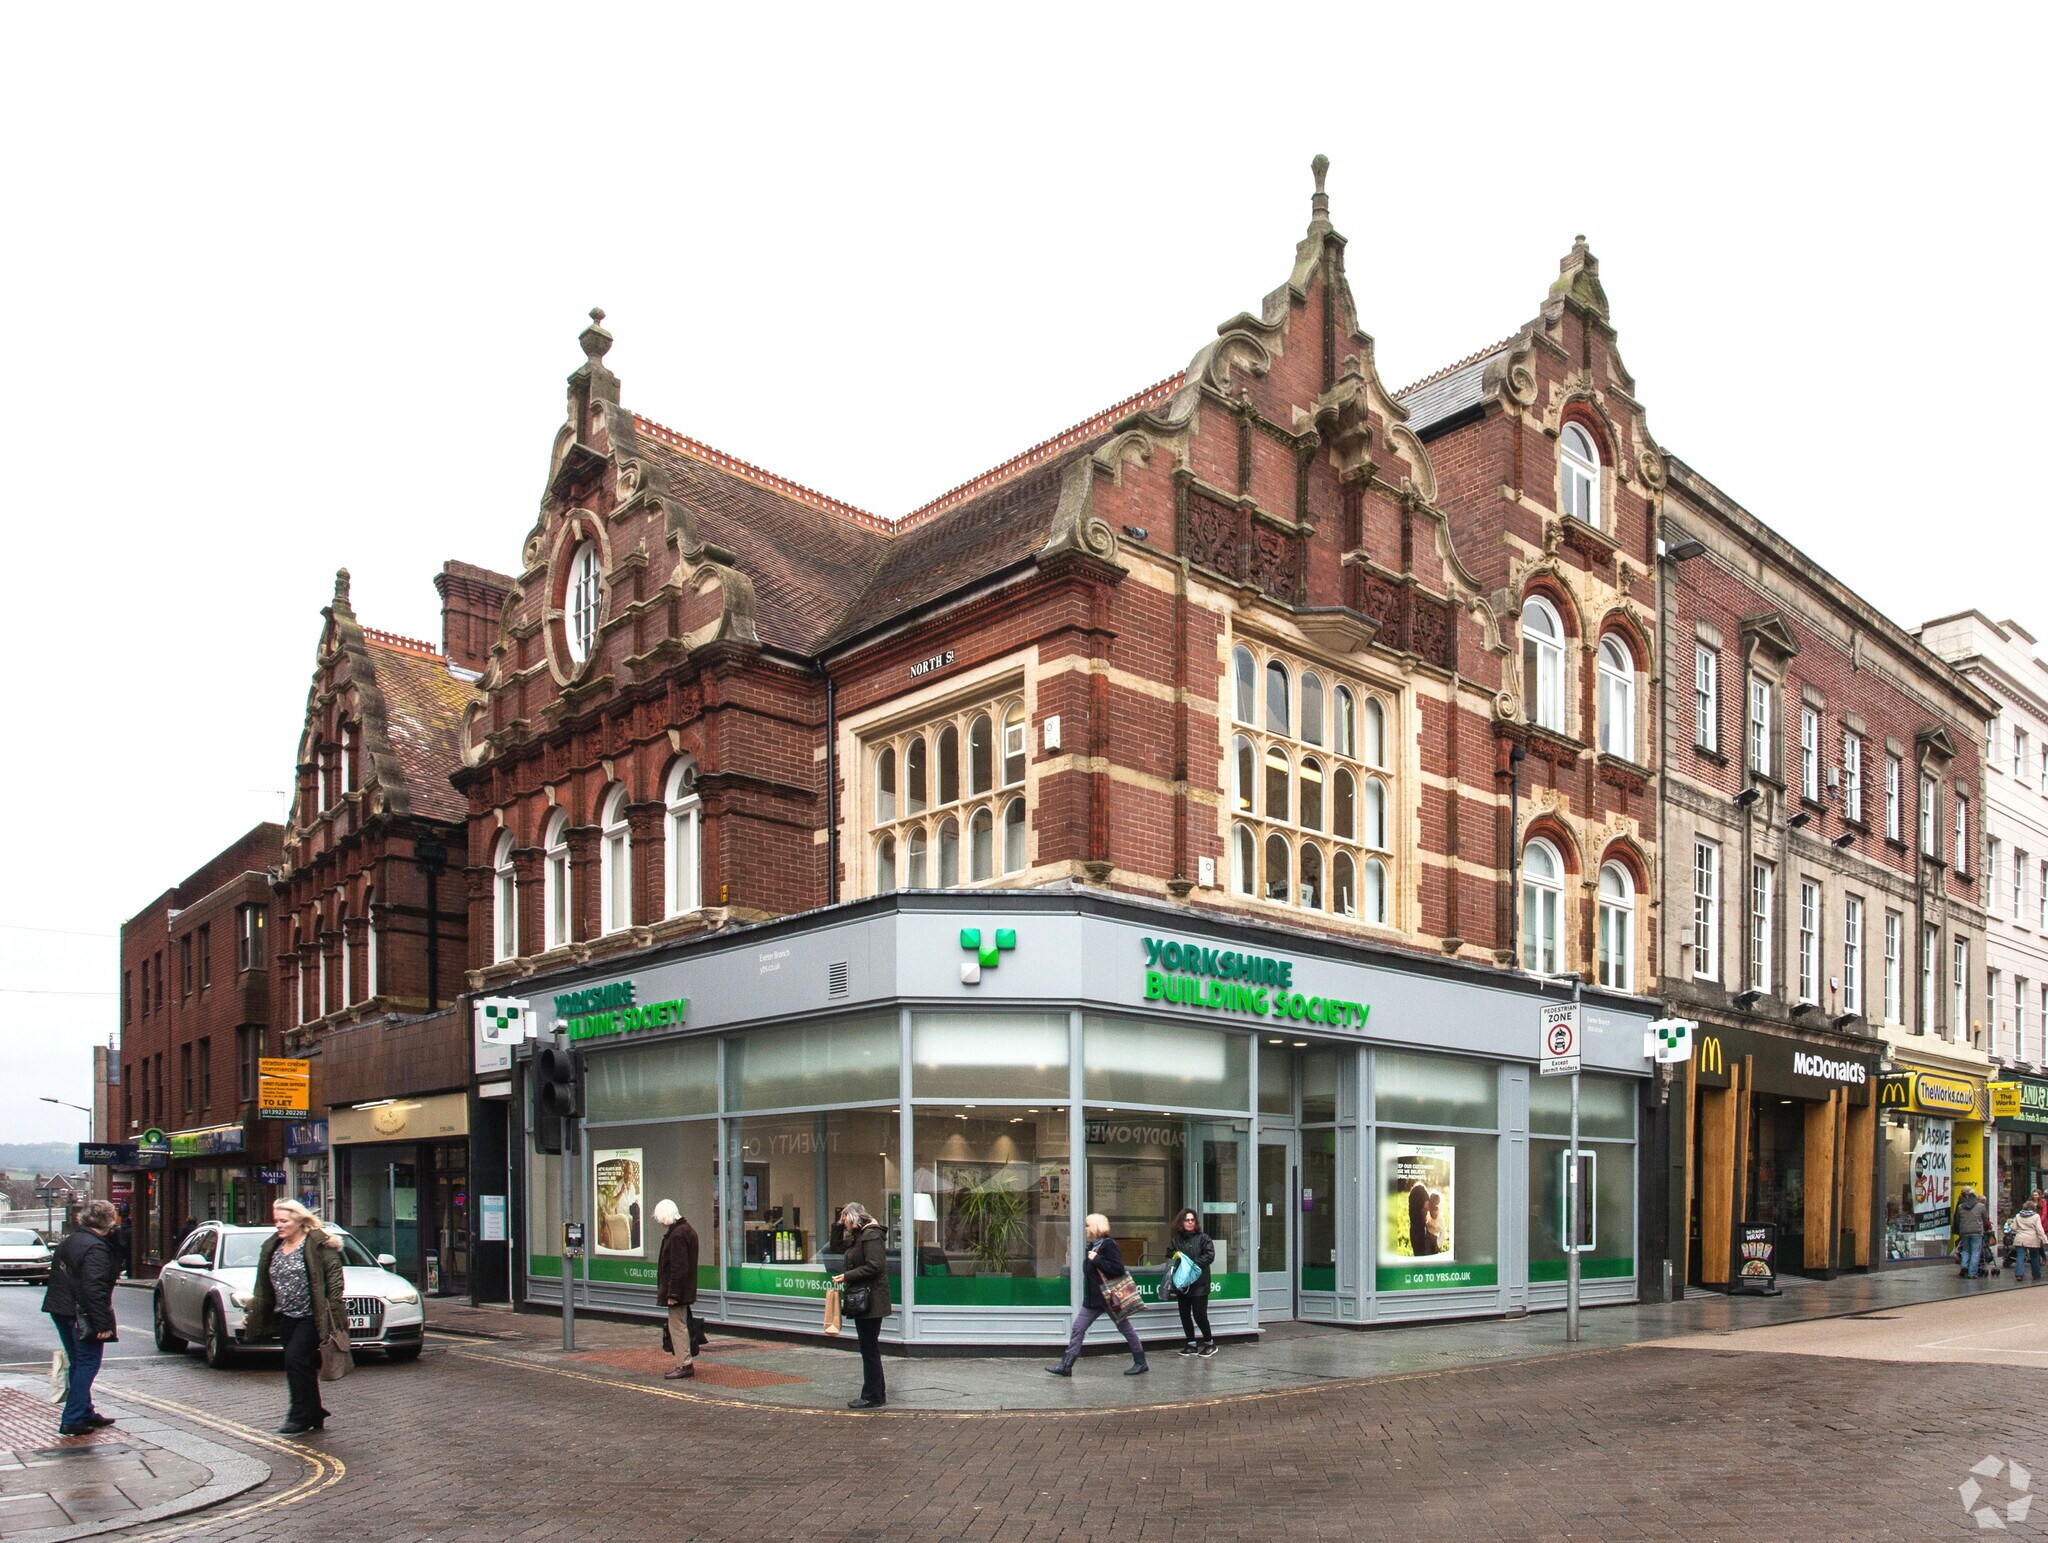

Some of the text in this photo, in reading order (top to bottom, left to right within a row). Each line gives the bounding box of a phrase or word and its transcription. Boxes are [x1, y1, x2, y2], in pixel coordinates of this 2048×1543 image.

[910, 655, 942, 678] NORTH
[1141, 937, 1293, 988] YORKSHIRE
[554, 980, 634, 1017] YORKSHIRE
[1144, 970, 1371, 1028] BUILDING SOCIETY
[565, 998, 686, 1039] ILDING SOCIETY
[1544, 1005, 1577, 1014] PEDESTRIAN
[1548, 1012, 1572, 1022] ZONE
[1793, 1052, 1866, 1084] McDonald's
[1920, 1082, 1973, 1105] TheWorks.co.uk
[84, 1149, 117, 1157] Bradleys
[1922, 1151, 1947, 1170] STOCK
[1914, 1175, 1950, 1205] SALE
[629, 1268, 658, 1278] CALL 0139
[1413, 1272, 1470, 1282] GO TO YBS.CO.UK
[783, 1279, 793, 1288] GO
[795, 1279, 804, 1289] TO
[1136, 1284, 1153, 1294] ALL
[350, 1318, 364, 1327] YB
